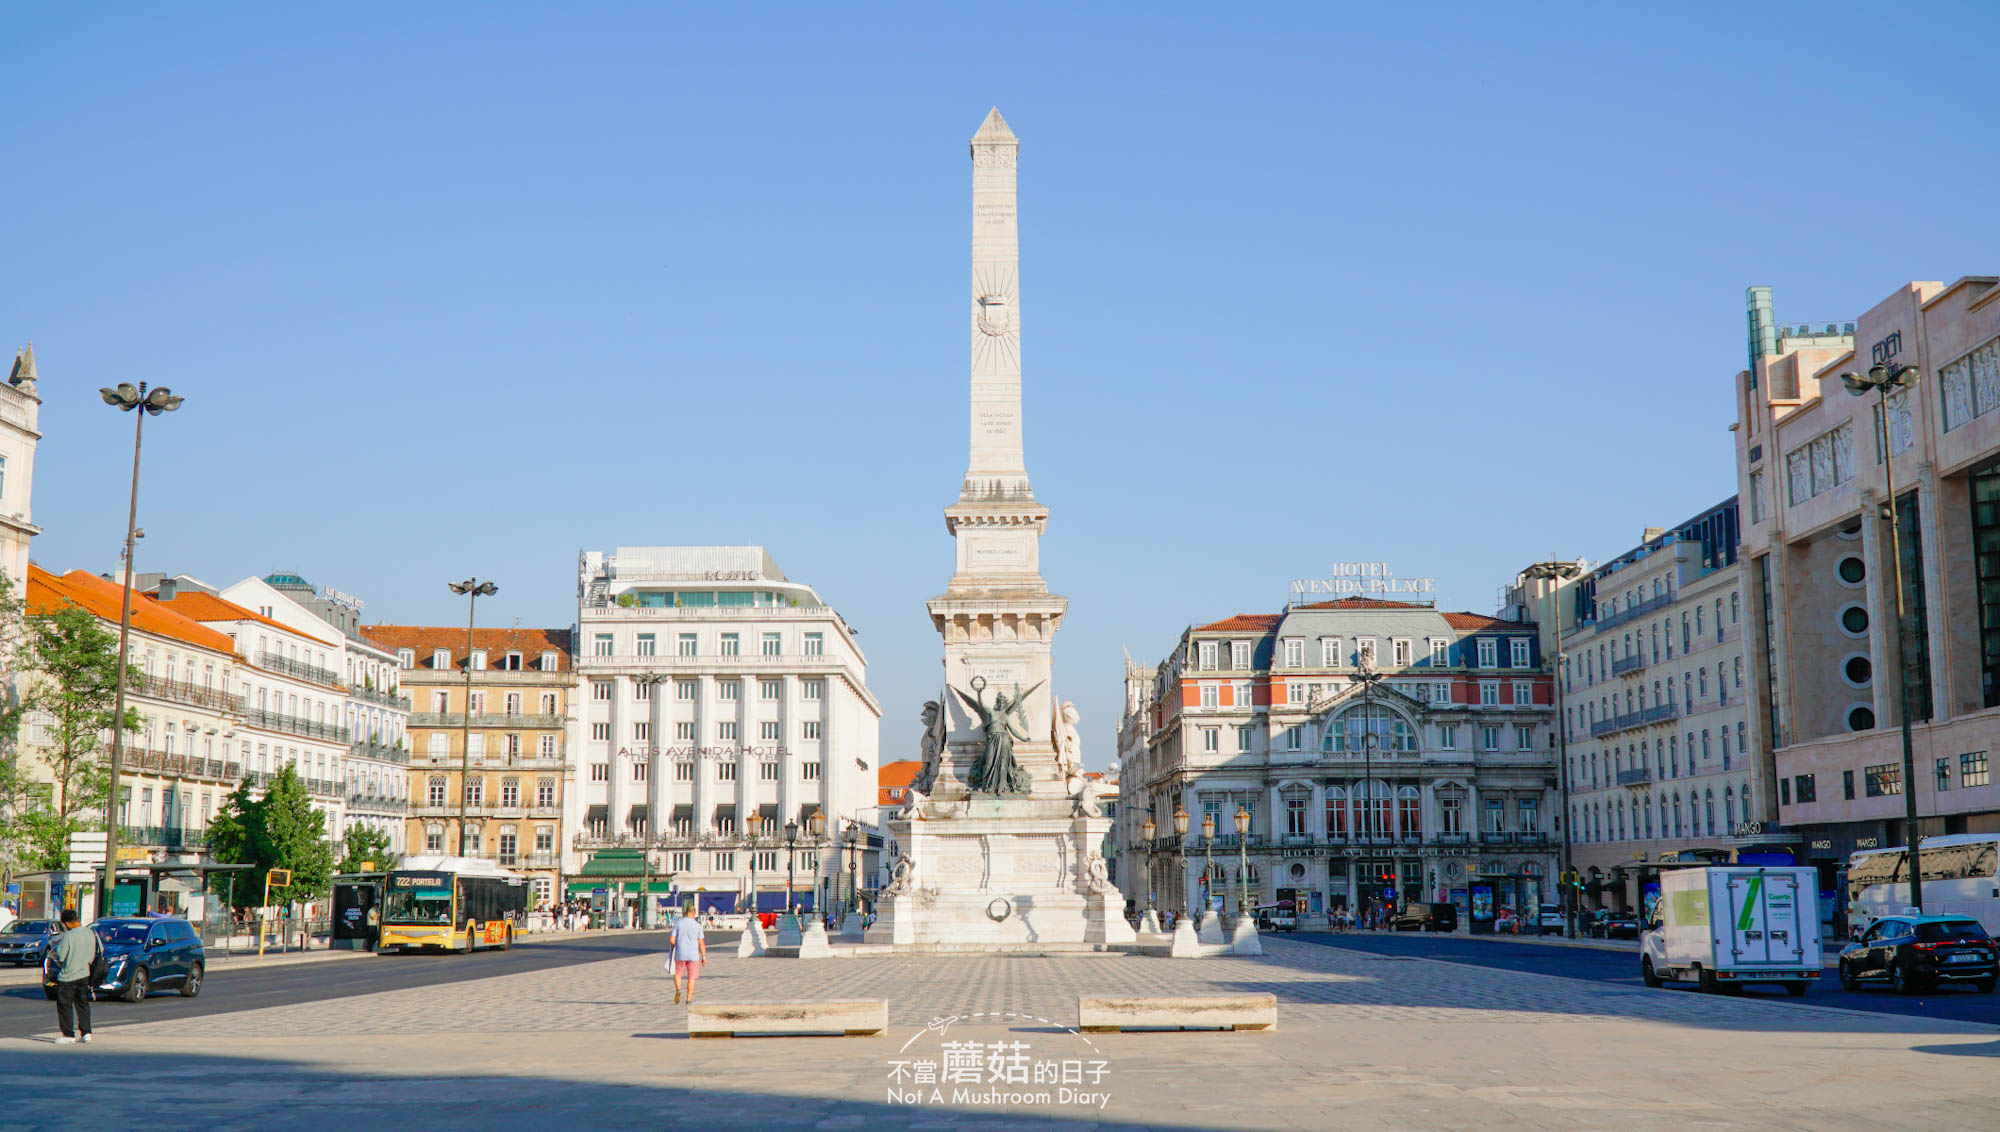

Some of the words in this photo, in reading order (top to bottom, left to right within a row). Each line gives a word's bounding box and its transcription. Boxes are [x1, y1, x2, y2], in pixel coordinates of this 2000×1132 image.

[1333, 562, 1393, 576] HOTEL
[1290, 579, 1363, 593] AVENIDA
[1370, 578, 1435, 593] PALACE
[618, 746, 660, 756] ALTS
[666, 746, 734, 756] AVENIDA
[741, 745, 793, 756] HOTEL
[1735, 821, 1762, 835] MANGO
[1811, 839, 1831, 849] MANGO
[1856, 837, 1878, 848] MANGO
[1283, 848, 1329, 857] HOTEL
[1417, 848, 1469, 857] PALACE
[396, 876, 411, 887] 722
